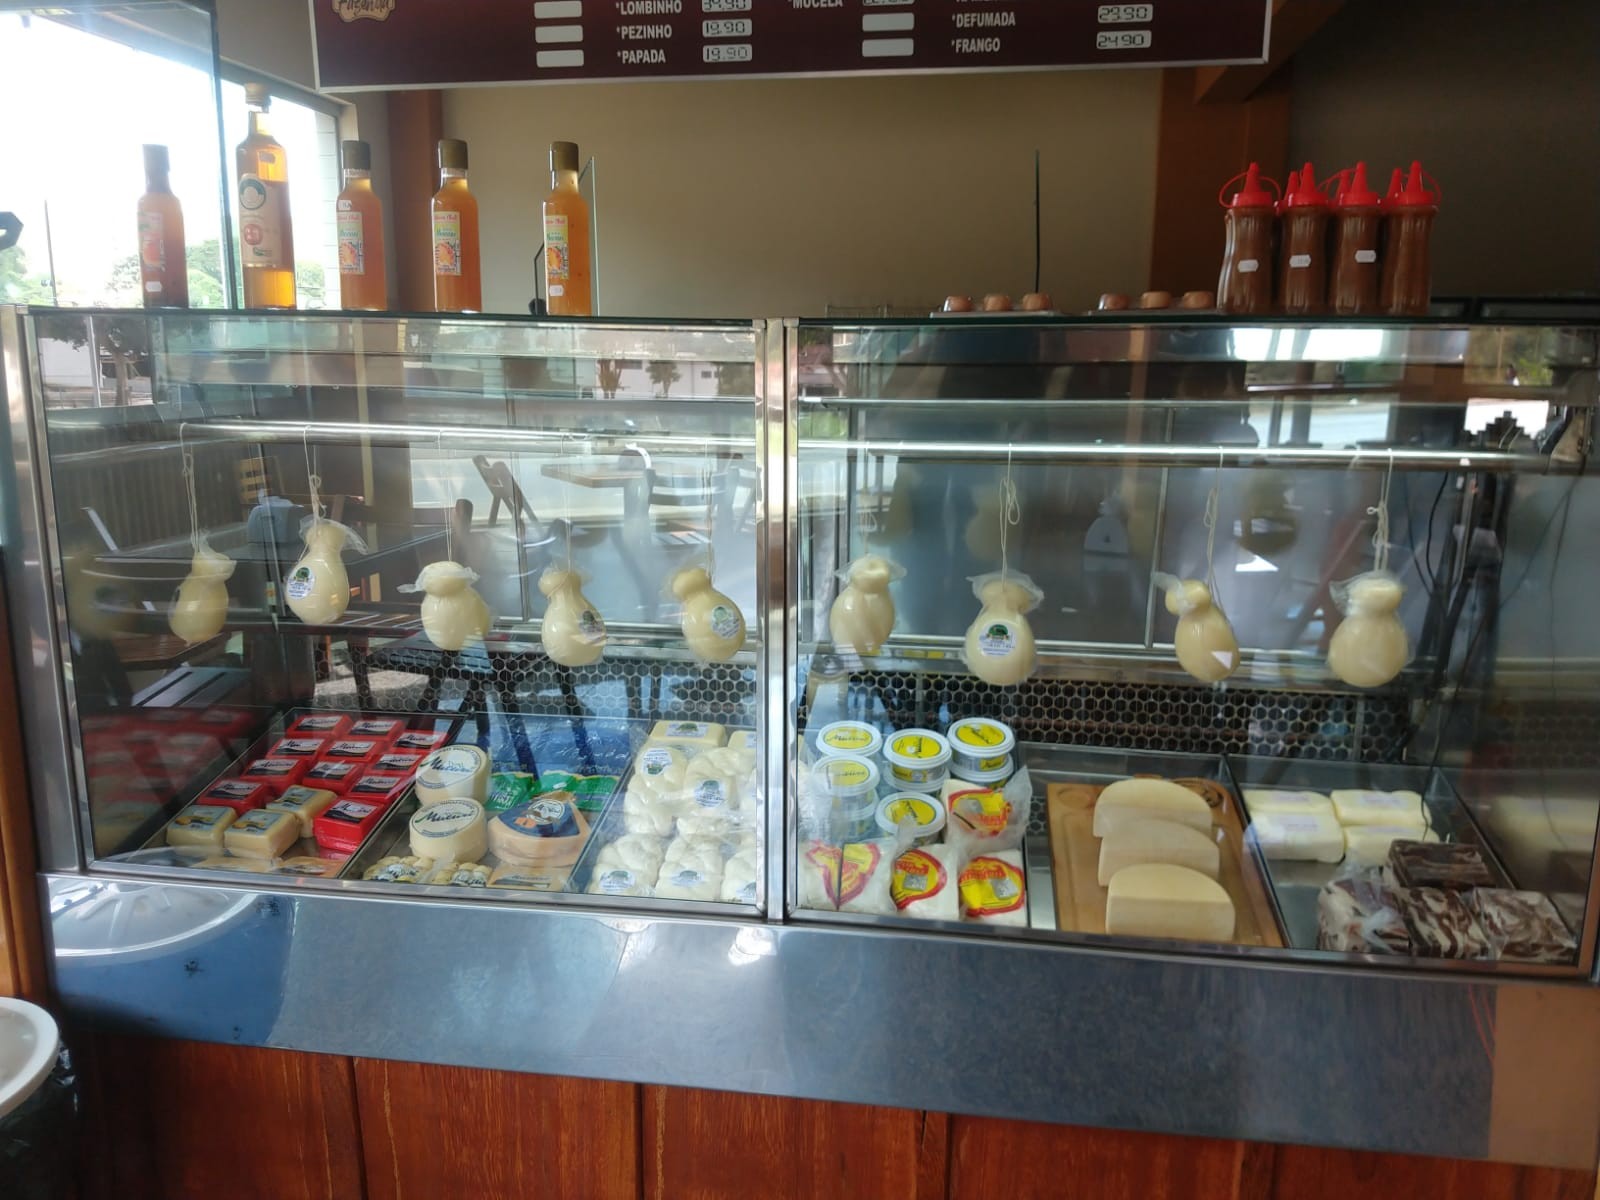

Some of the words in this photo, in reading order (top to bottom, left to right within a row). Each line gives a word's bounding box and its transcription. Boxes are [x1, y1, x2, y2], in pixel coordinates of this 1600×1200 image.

[620, 0, 682, 15] LOMBINHO
[956, 12, 1016, 28] DEFUMADA
[621, 24, 673, 40] PEZINHO
[955, 38, 1001, 53] FRANGO
[622, 49, 667, 64] PAPADA
